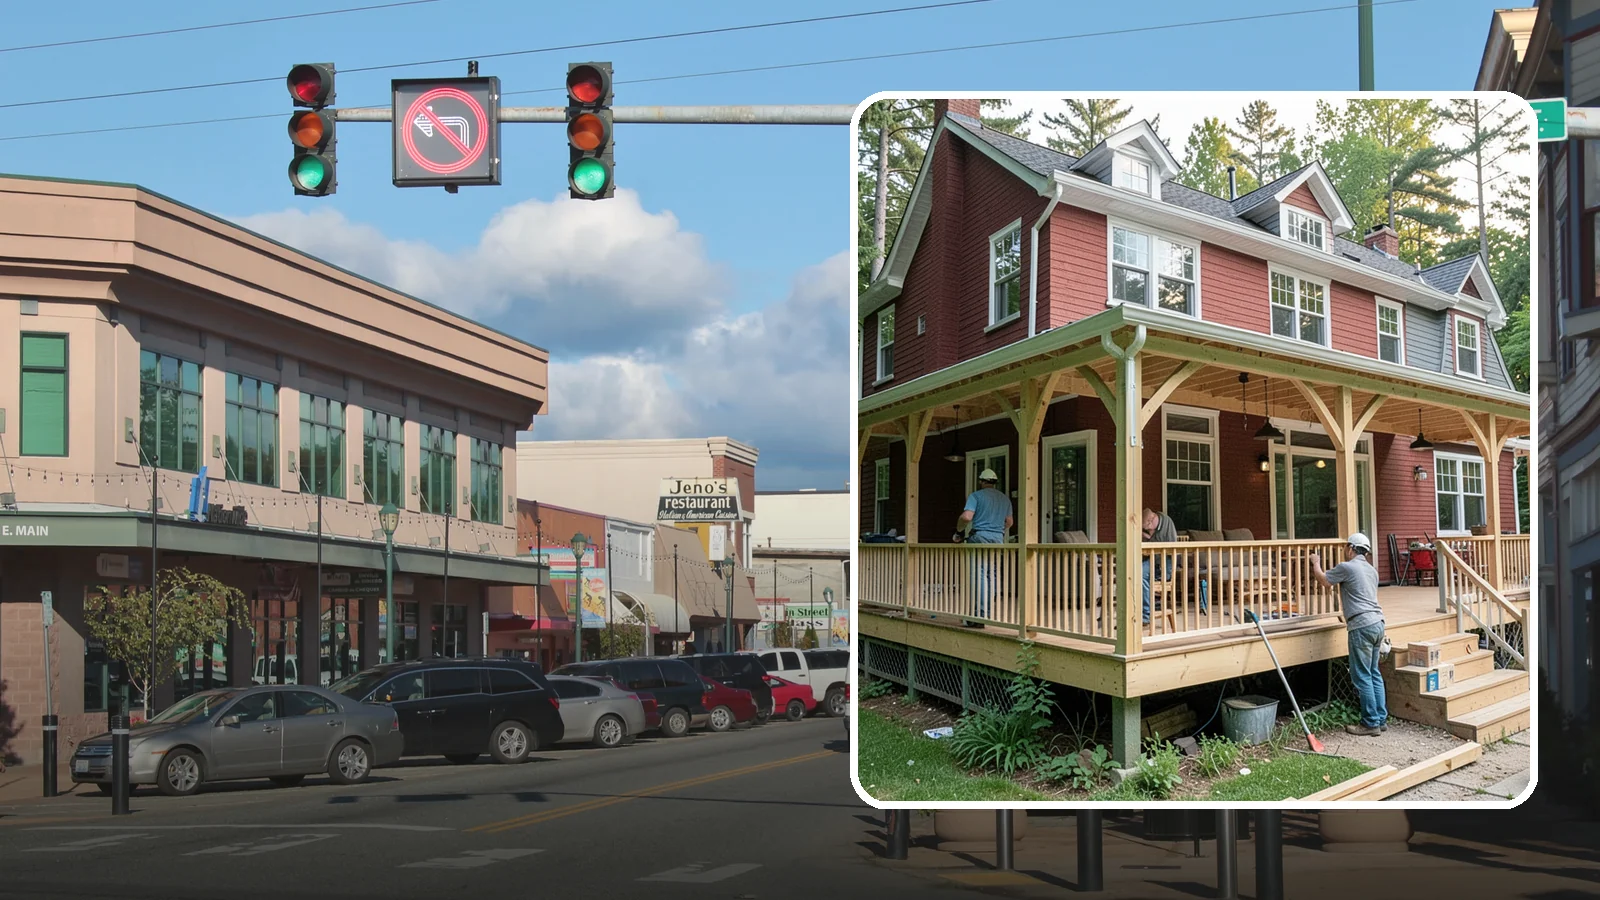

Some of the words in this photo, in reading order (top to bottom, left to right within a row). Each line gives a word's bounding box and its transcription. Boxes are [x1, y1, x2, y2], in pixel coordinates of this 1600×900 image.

[669, 480, 728, 494] Jeno's
[665, 496, 731, 509] restaurant
[658, 509, 681, 519] Italian
[686, 509, 714, 519] American
[715, 509, 737, 519] Cuisine
[2, 525, 13, 536] E.
[15, 525, 48, 536] MAIN
[797, 607, 828, 616] Street
